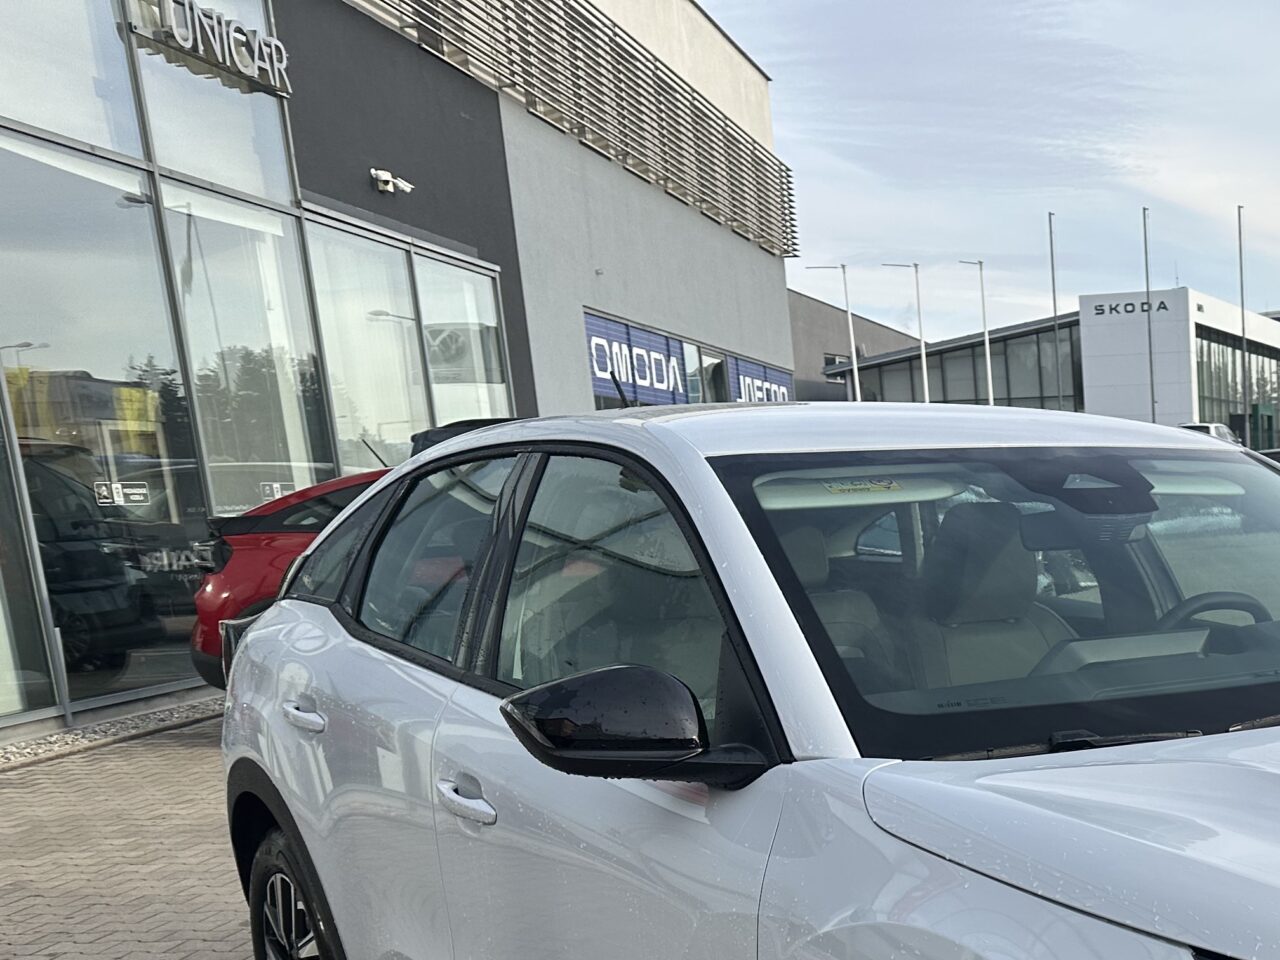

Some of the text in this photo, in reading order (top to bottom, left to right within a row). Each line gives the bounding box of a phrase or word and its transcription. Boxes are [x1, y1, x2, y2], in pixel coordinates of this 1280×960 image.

[171, 0, 292, 93] UNICAR
[590, 336, 684, 393] OMODA
[736, 375, 788, 402] JAECOO
